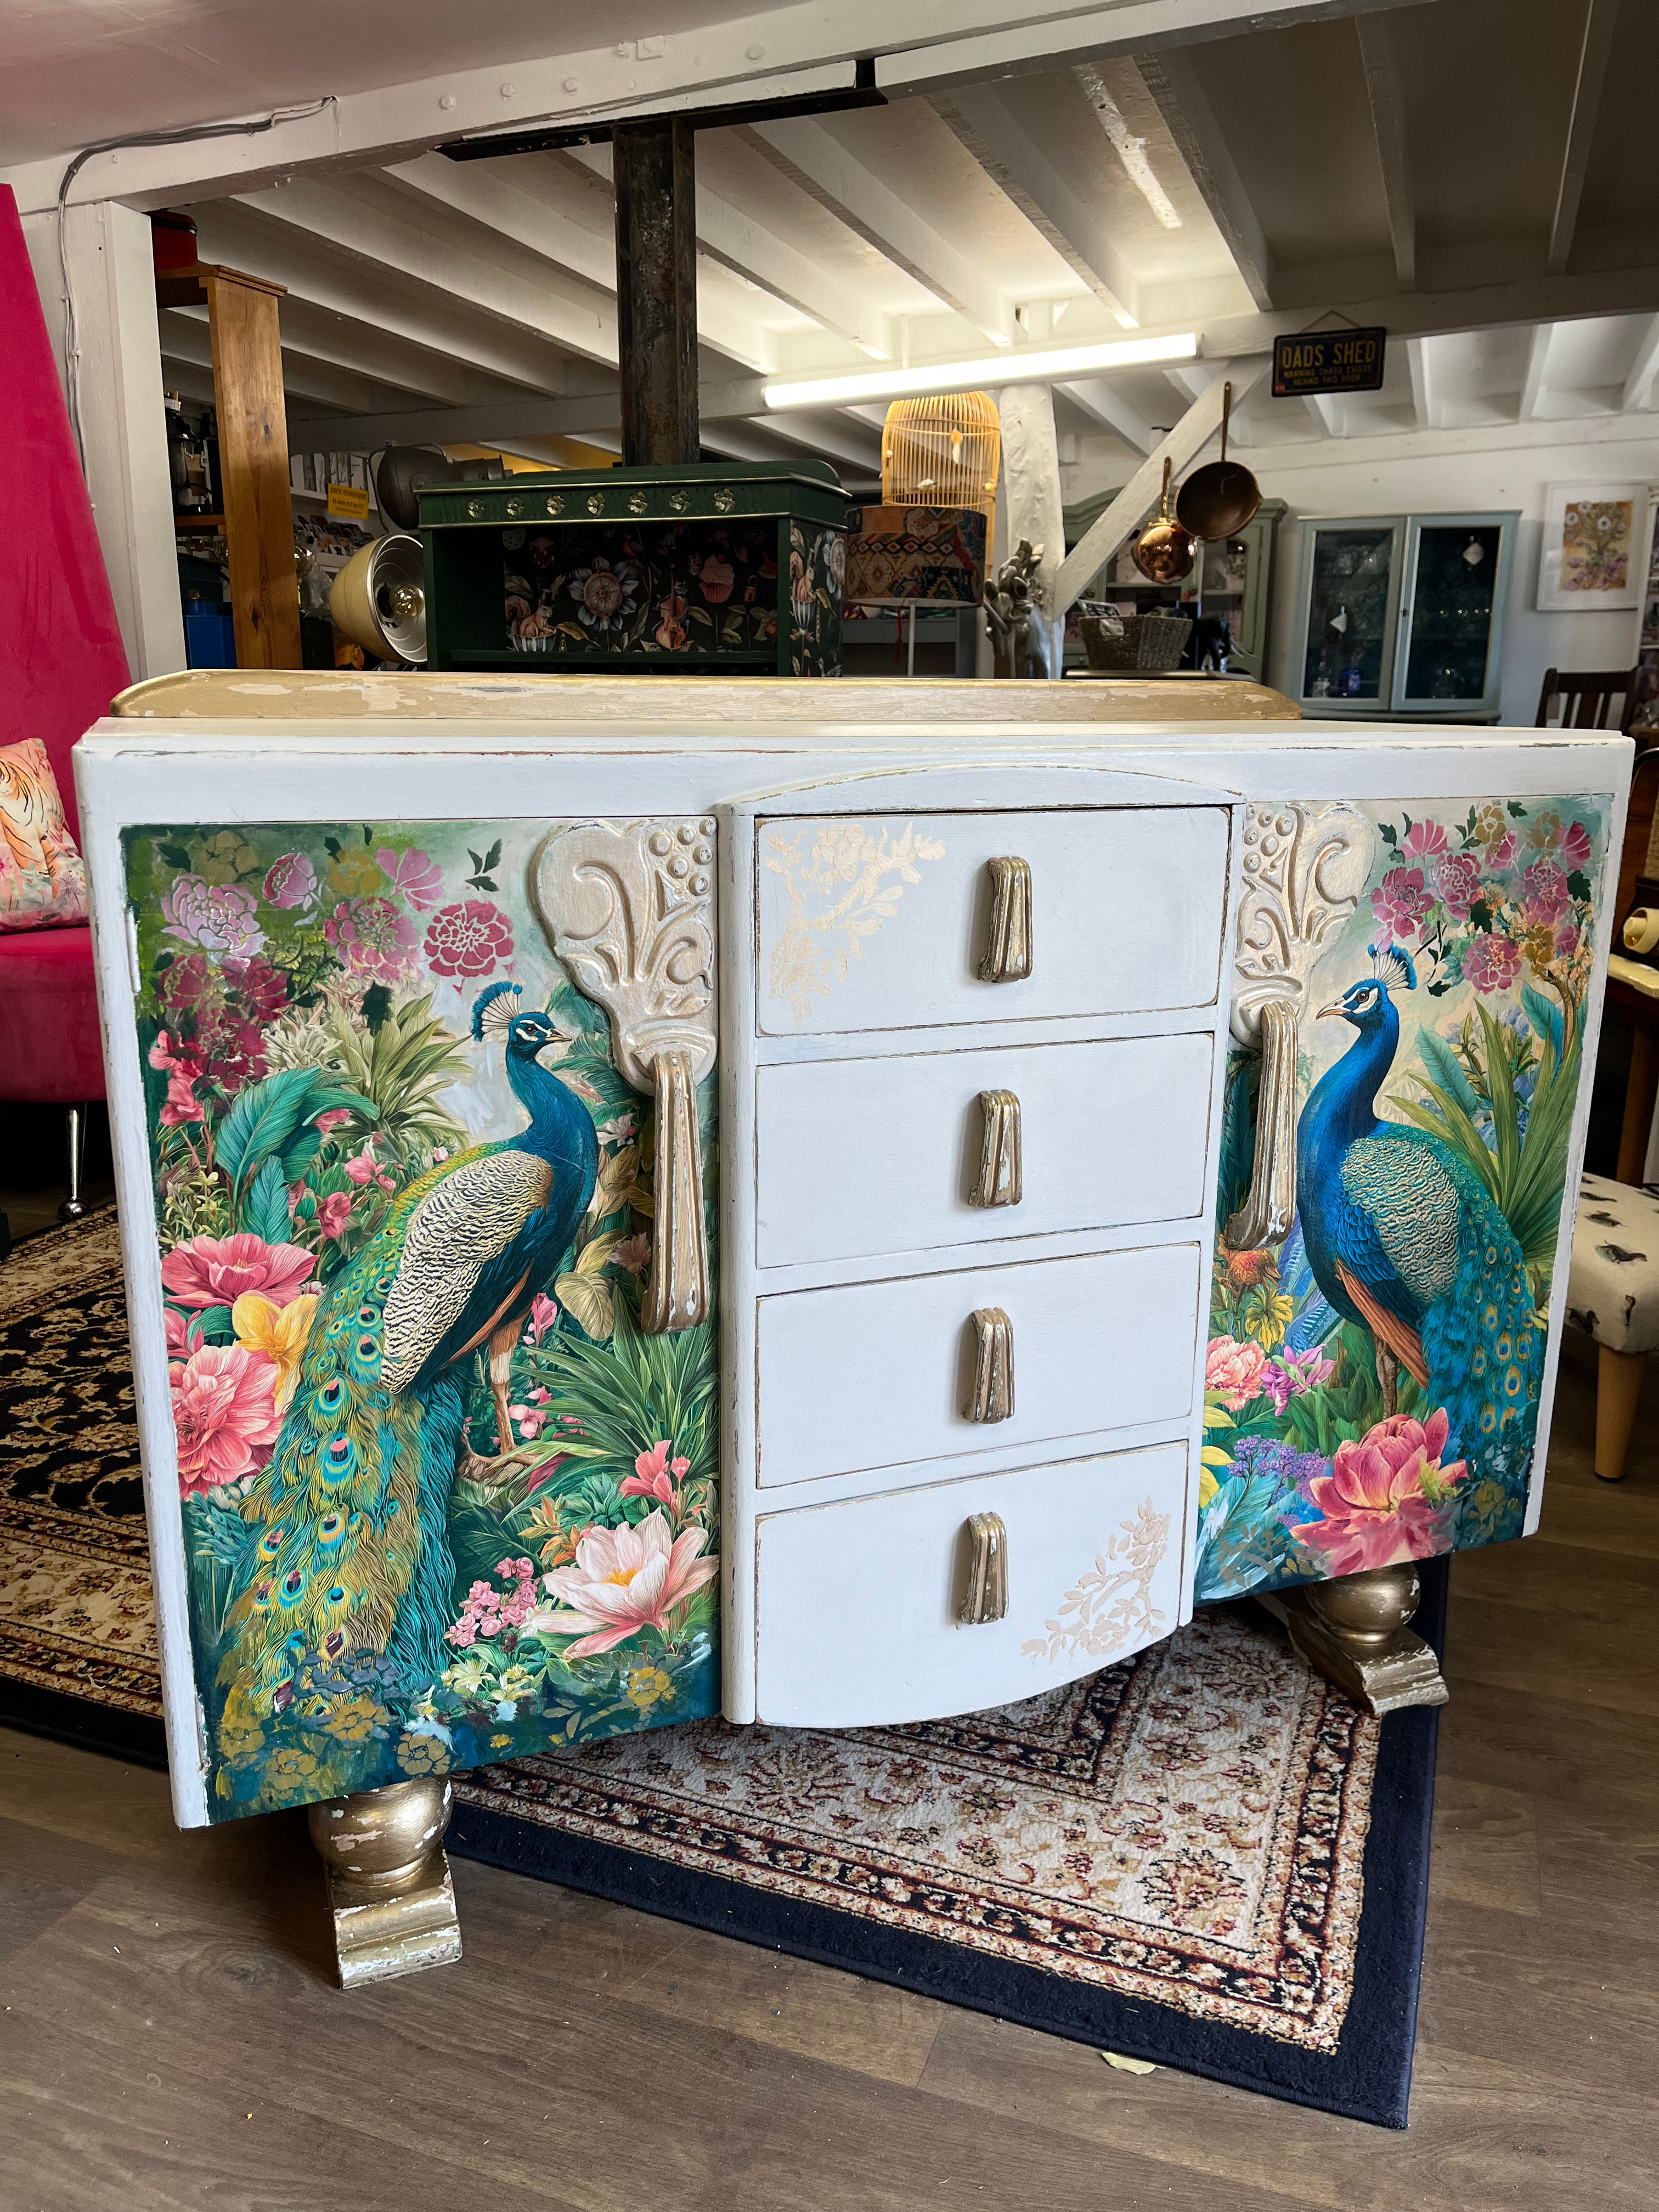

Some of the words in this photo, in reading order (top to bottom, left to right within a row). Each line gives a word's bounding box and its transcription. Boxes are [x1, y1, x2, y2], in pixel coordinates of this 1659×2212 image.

[1282, 345, 1325, 369] DADS
[1333, 340, 1376, 365] SHED
[1283, 368, 1317, 379] WARNING
[1293, 376, 1319, 386] BEHIND
[1322, 375, 1339, 384] THIS
